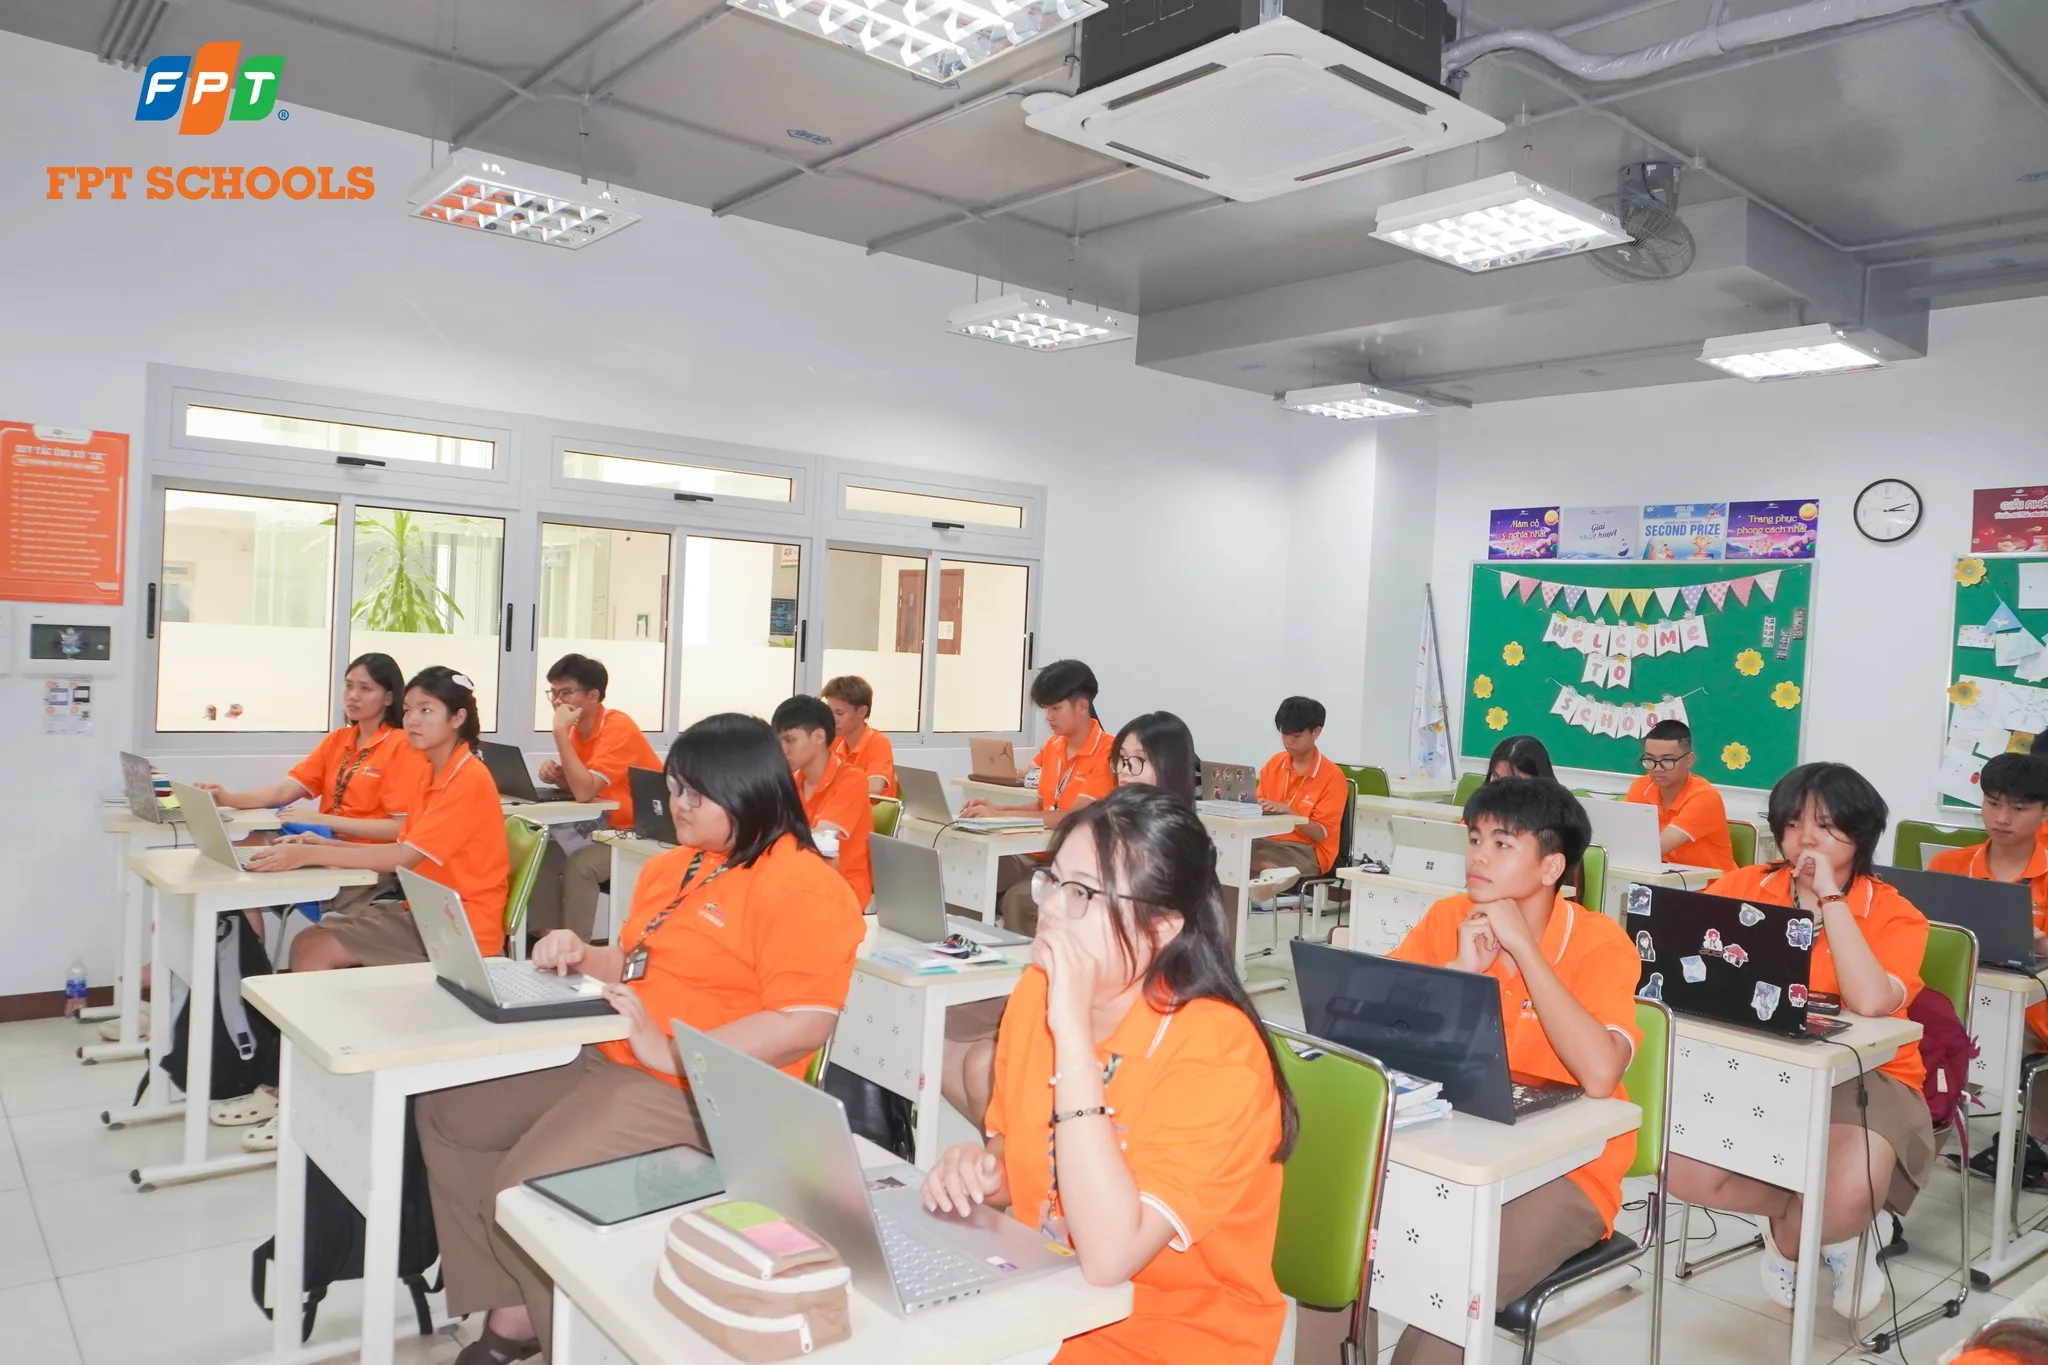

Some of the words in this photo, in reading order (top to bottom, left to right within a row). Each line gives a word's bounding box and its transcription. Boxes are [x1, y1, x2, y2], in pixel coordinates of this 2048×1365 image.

[2025, 495, 2048, 510] NHẤ
[1748, 514, 1774, 524] Trang
[1645, 524, 1687, 537] SECOND
[1689, 523, 1721, 536] PRIZE
[1736, 526, 1764, 536] phong
[1764, 525, 1786, 533] cách
[1591, 662, 1626, 681] TO
[1560, 697, 1683, 731] SCHOOL
